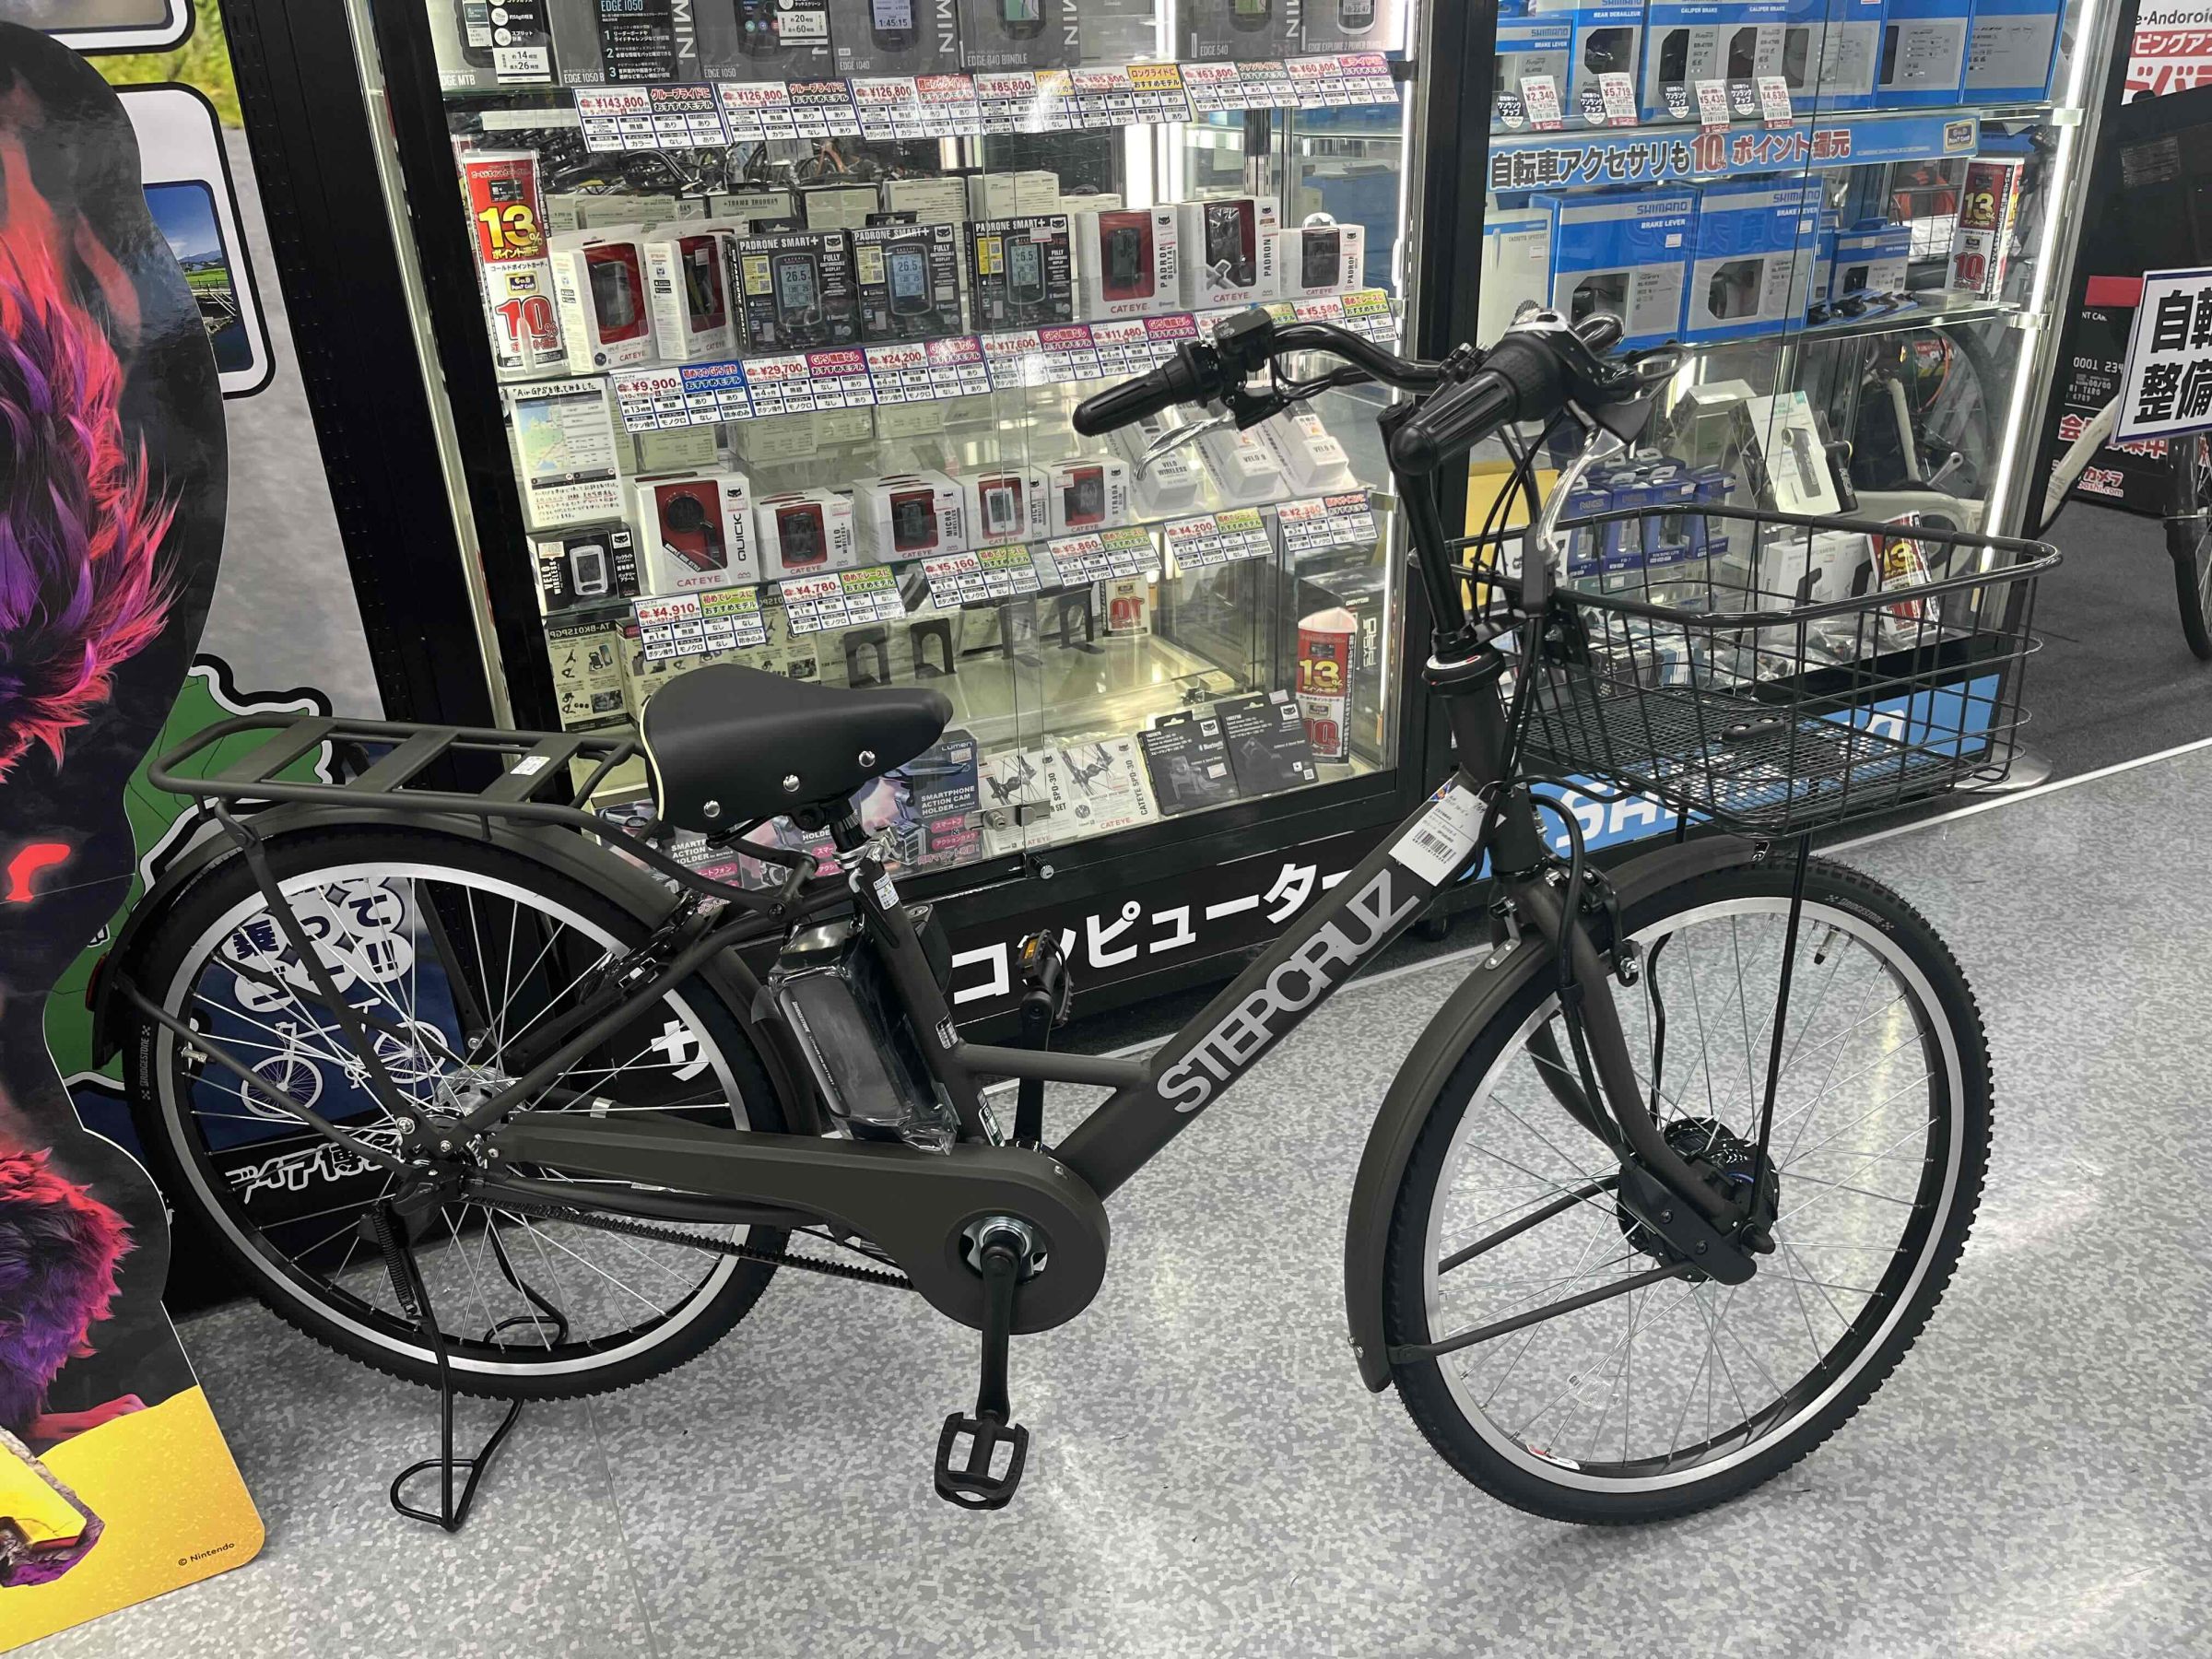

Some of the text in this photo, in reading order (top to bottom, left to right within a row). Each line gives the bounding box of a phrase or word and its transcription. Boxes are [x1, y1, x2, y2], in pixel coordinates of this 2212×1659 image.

[879, 18, 908, 28] 1:45:15
[1531, 28, 1569, 37] SHIMANO
[1200, 46, 1216, 55] EDGE
[840, 61, 855, 70] EDGE
[967, 56, 985, 67] EDGE
[564, 73, 582, 84] EDGE
[703, 68, 720, 78] EDGE
[651, 88, 712, 100] グループライドに
[789, 82, 846, 94] グループライドに
[793, 94, 848, 104] おすすめモデル
[653, 100, 714, 112] おすすめモデル
[1772, 189, 1820, 204] SHIMANO
[1636, 200, 1688, 215] SHIMANO
[1776, 207, 1797, 217] BRAKE
[478, 203, 544, 249] 13%
[975, 218, 1046, 233] PADRONE SMART+
[1641, 218, 1686, 229] BRAKE LEVER
[853, 226, 930, 241] PADRONE SMART+
[739, 236, 819, 252] PADRONE SMART+
[933, 244, 950, 253] FULLY
[823, 253, 841, 262] FULLY
[898, 261, 918, 273] 26.5
[785, 270, 807, 282] 26.5
[1110, 304, 1148, 314] CATEYE
[495, 295, 559, 341] 10%
[2074, 357, 2098, 371] 0001
[908, 390, 932, 399] モノクロ
[788, 401, 813, 410] モノクロ
[661, 417, 687, 426] モノクロ
[1312, 444, 1330, 453] VELO
[1161, 460, 1178, 469] VELO
[1243, 454, 1260, 463] VELO
[1157, 465, 1188, 477] WIRELESS
[2083, 466, 2124, 487] カメラ
[733, 513, 747, 562] QUICK
[1299, 659, 1344, 688] 13%
[922, 785, 975, 802] SMARTPHONE
[922, 794, 971, 809] ACTION CAM
[1135, 787, 1148, 816] CATEYE
[922, 804, 954, 816] HOLDER
[672, 847, 707, 859] ACTION
[1838, 898, 1886, 924] BRIDGESTONE
[1157, 868, 1420, 1113] STEPCRUZ
[139, 1037, 149, 1087] BRIDGESTONE
[189, 1541, 236, 1563] Nintendo
